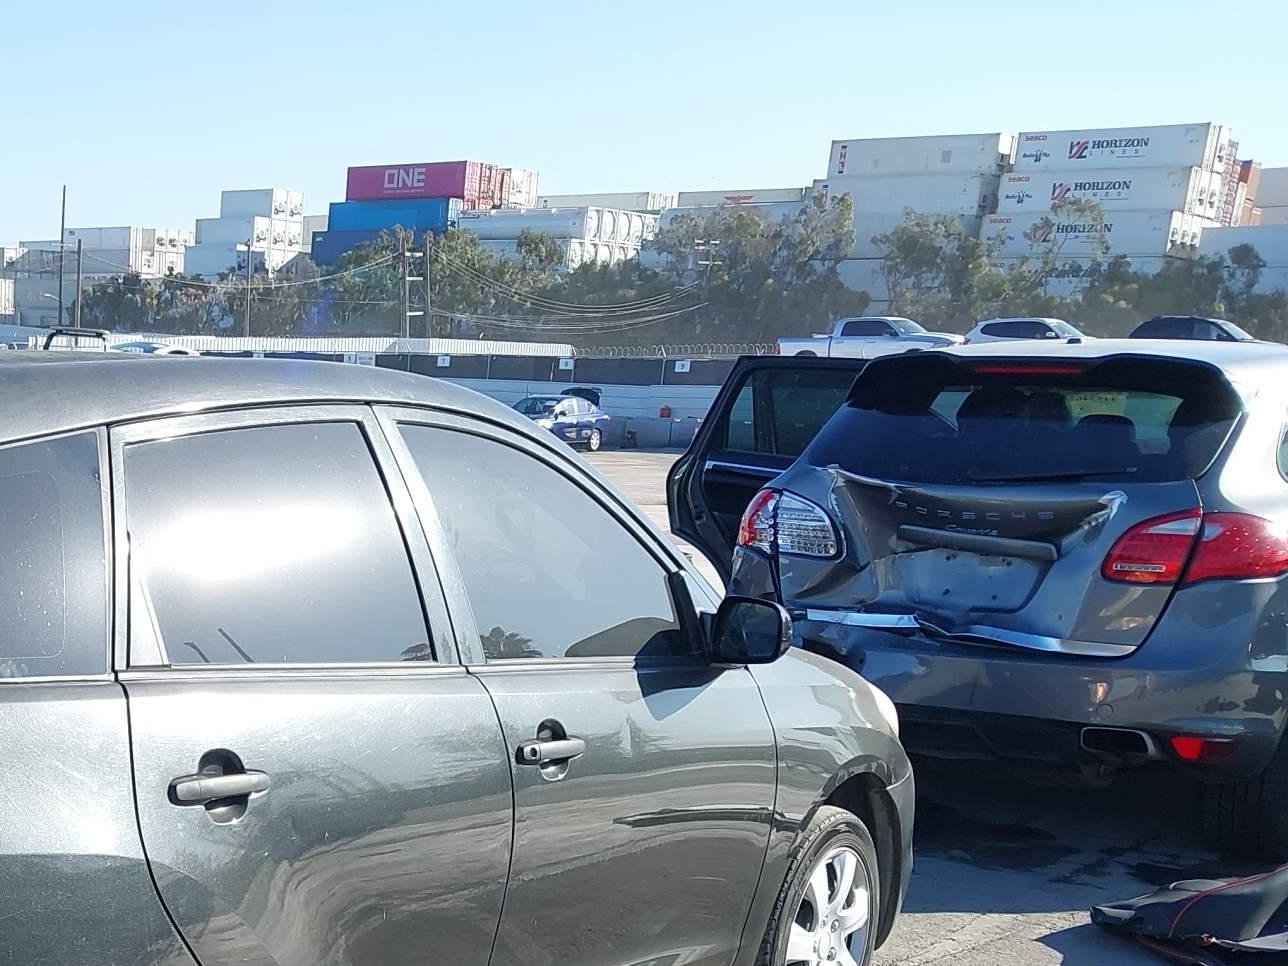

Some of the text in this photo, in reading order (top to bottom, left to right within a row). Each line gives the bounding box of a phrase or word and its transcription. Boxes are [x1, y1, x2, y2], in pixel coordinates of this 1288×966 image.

[1092, 138, 1150, 149] HORIZON
[1090, 149, 1139, 157] LINES
[384, 168, 426, 188] ONE
[1074, 181, 1132, 191] HORIZON
[1057, 223, 1113, 233] HORIZON
[896, 501, 1054, 520] PORSCHE
